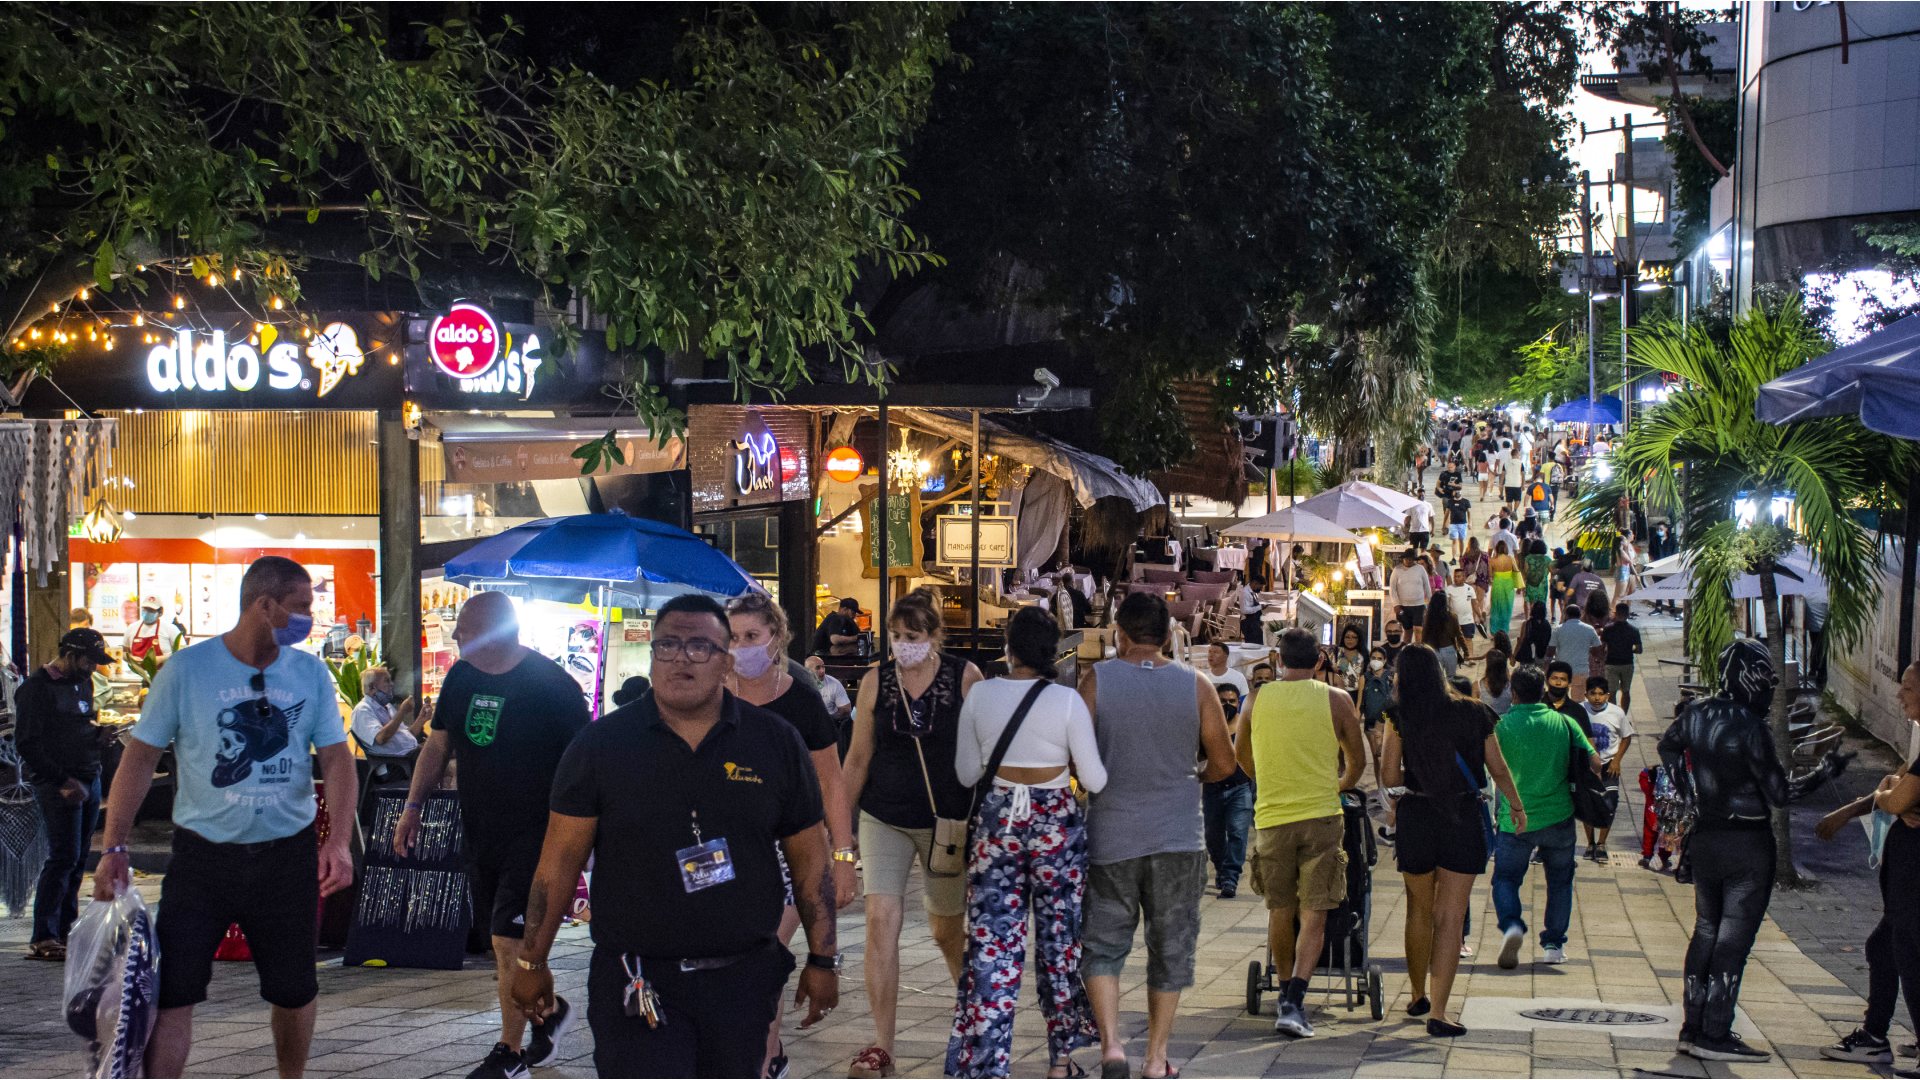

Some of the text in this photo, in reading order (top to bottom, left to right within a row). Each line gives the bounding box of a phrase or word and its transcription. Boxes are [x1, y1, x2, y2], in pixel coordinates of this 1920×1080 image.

[437, 323, 493, 343] aldo's
[147, 323, 302, 392] aldo's
[102, 608, 119, 617] SIN
[475, 699, 499, 708] AUSTIN
